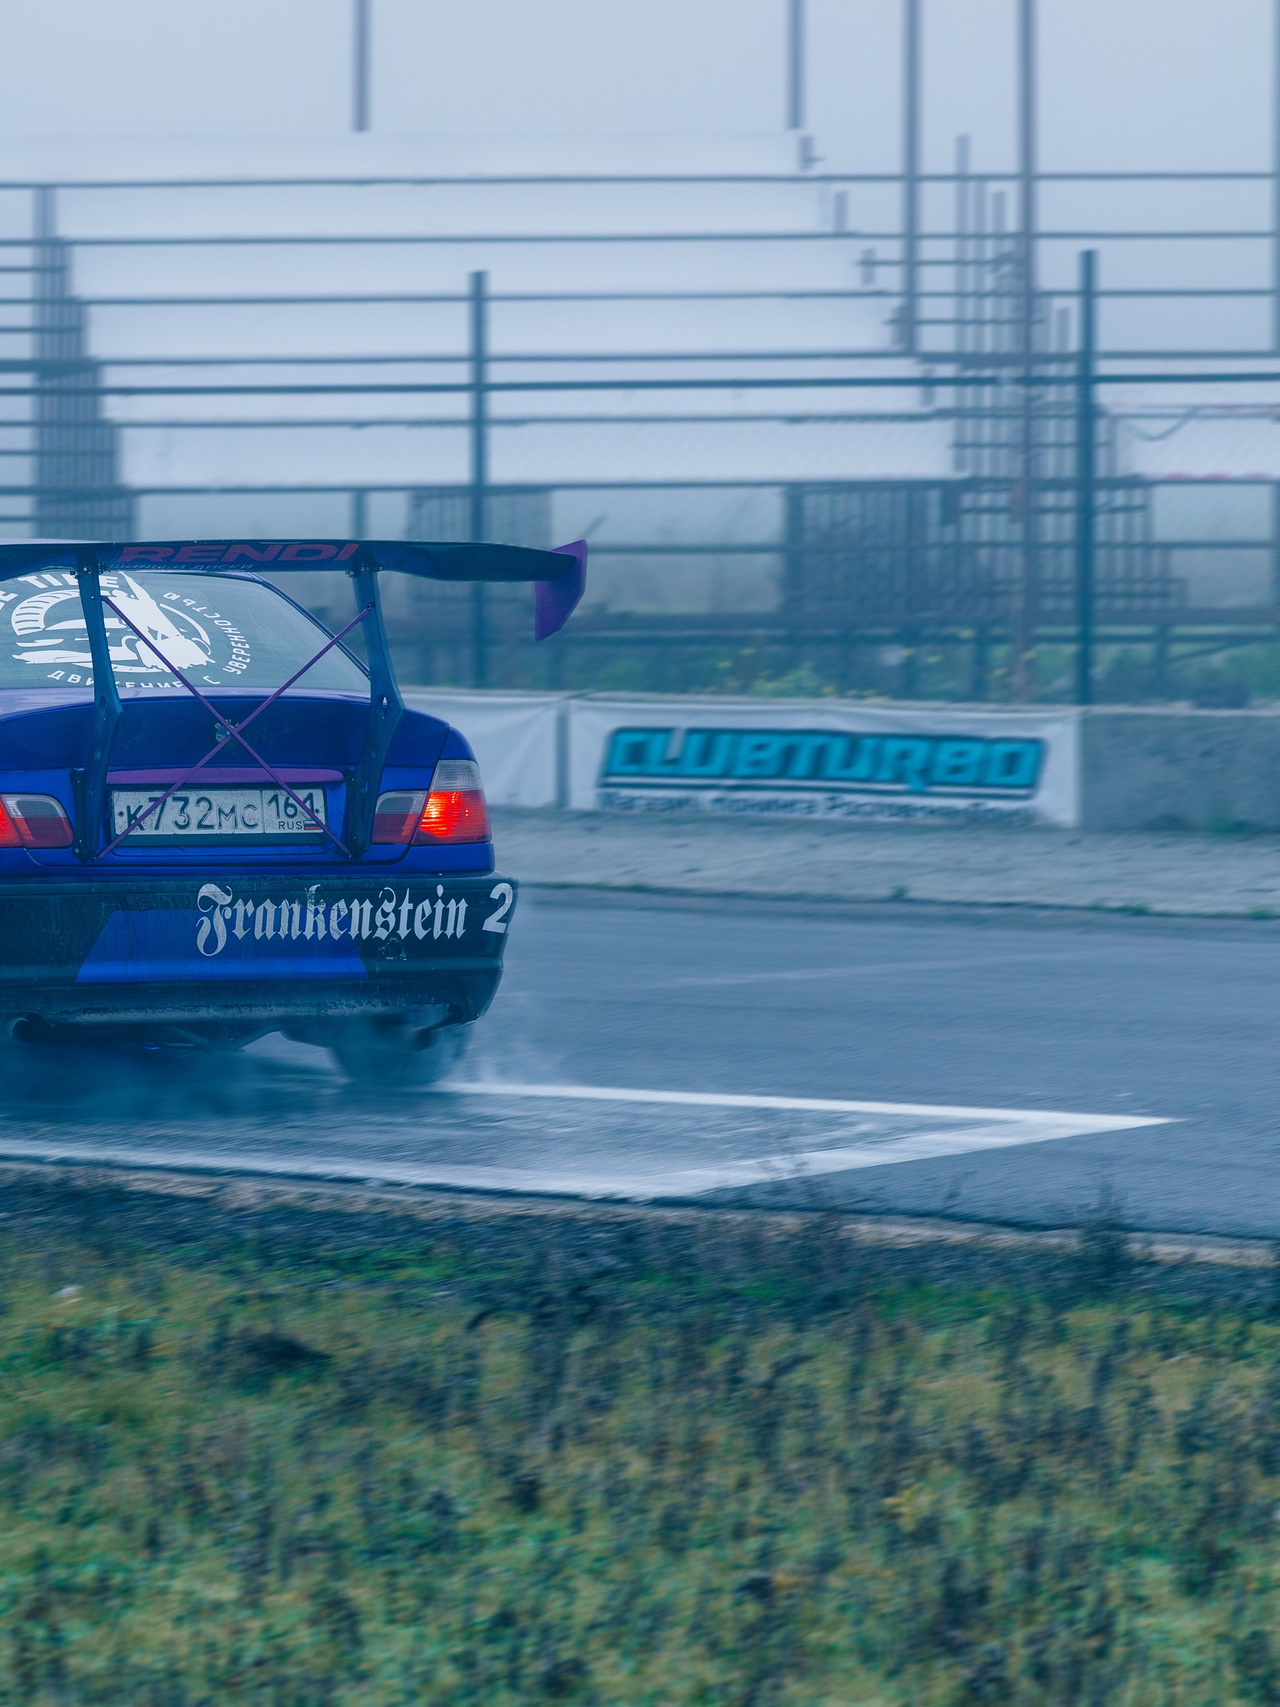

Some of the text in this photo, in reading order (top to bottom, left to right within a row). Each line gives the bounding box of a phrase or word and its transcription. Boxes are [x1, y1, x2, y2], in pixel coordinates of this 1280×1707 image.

[117, 544, 360, 563] RENDI
[46, 669, 185, 689] ДВИЕНИЕ
[162, 592, 252, 675] УВЕРЕННОСТЬЮ
[608, 730, 1044, 792] CLUBTURBO
[267, 792, 315, 820] 161
[278, 820, 303, 830] RUS
[196, 882, 514, 957] Frankenstein 2
